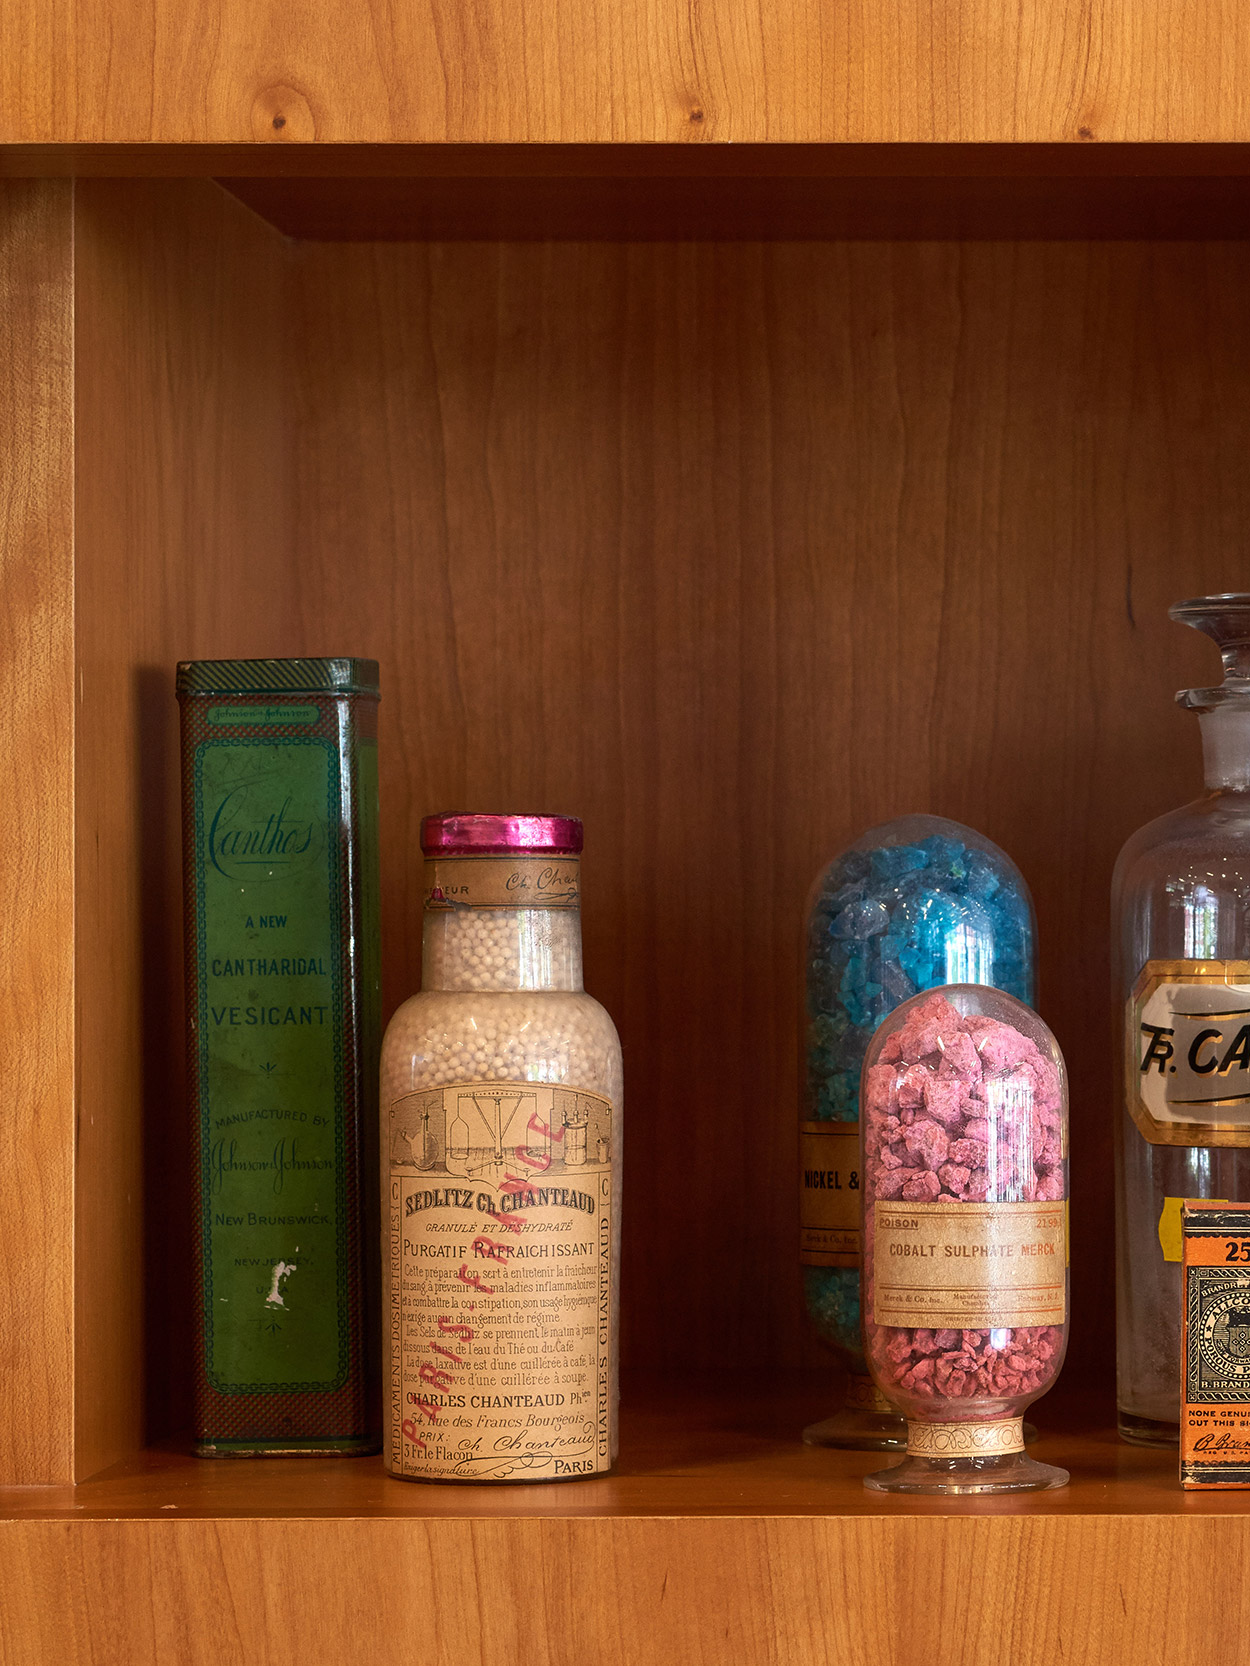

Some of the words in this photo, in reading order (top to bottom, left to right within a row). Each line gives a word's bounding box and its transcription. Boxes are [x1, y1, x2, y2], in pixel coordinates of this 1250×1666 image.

[209, 781, 316, 882] Canthos
[245, 916, 254, 928] A
[260, 915, 287, 928] NEW
[212, 958, 326, 976] CANTHARIDAL
[211, 1006, 328, 1025] VESICANT
[215, 1109, 307, 1130] MANUFACTURED
[312, 1115, 330, 1128] BY
[805, 1170, 842, 1190] NICKEL
[848, 1170, 860, 1190] &
[405, 1188, 474, 1217] SEDLITZ
[501, 1187, 595, 1215] CHANTEAUD
[462, 1112, 565, 1295] FRANCE
[426, 1222, 477, 1233] GRANULÉ
[482, 1223, 495, 1233] ET
[879, 1218, 919, 1229] POISON
[404, 1239, 467, 1259] PURGATIF
[474, 1241, 594, 1259] RAFRAICHISSANT
[889, 1243, 935, 1257] COBALT
[944, 1244, 1013, 1258] SULPHATE
[1021, 1242, 1055, 1256] MERCK
[391, 1214, 400, 1340] DOSIMETRIQUES
[491, 1282, 533, 1293] maladies
[536, 1278, 597, 1292] inflammatoires
[599, 1217, 608, 1345] CHANTEAUD
[456, 1312, 512, 1329] changement
[1205, 1337, 1237, 1373] POROUS
[391, 1345, 400, 1465] MEDICAMENTS
[406, 1392, 465, 1407] CHARLES
[471, 1394, 564, 1408] CHANTEAUD
[599, 1355, 607, 1456] CHARLES
[428, 1415, 449, 1427] Rue
[453, 1415, 472, 1427] des
[476, 1415, 522, 1428] Francs
[526, 1413, 584, 1432] Bourgeois
[436, 1446, 473, 1460] Flacon
[554, 1460, 593, 1474] PARIS
